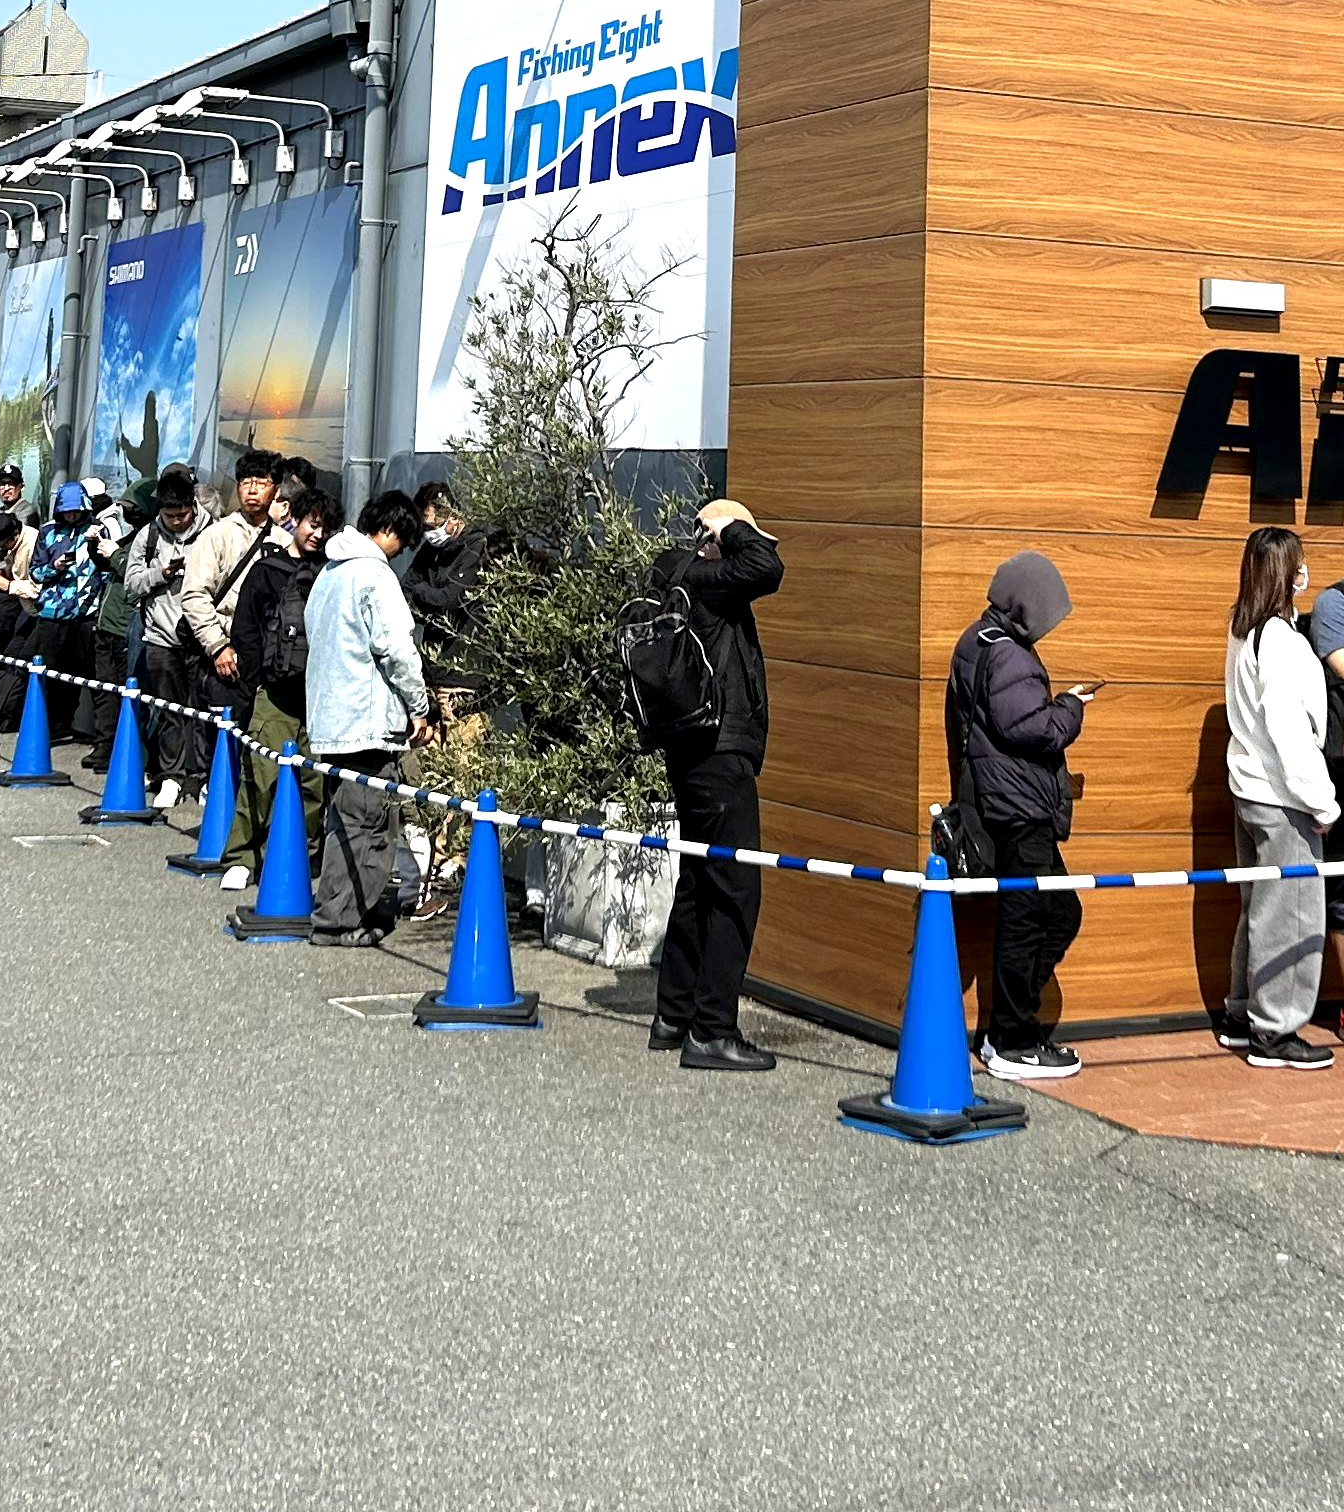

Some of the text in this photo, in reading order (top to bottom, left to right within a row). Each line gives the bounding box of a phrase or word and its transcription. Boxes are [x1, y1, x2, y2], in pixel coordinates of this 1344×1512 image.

[518, 9, 663, 86] Fishing Eight
[441, 46, 739, 216] Annex
[109, 260, 145, 285] SHIMANO
